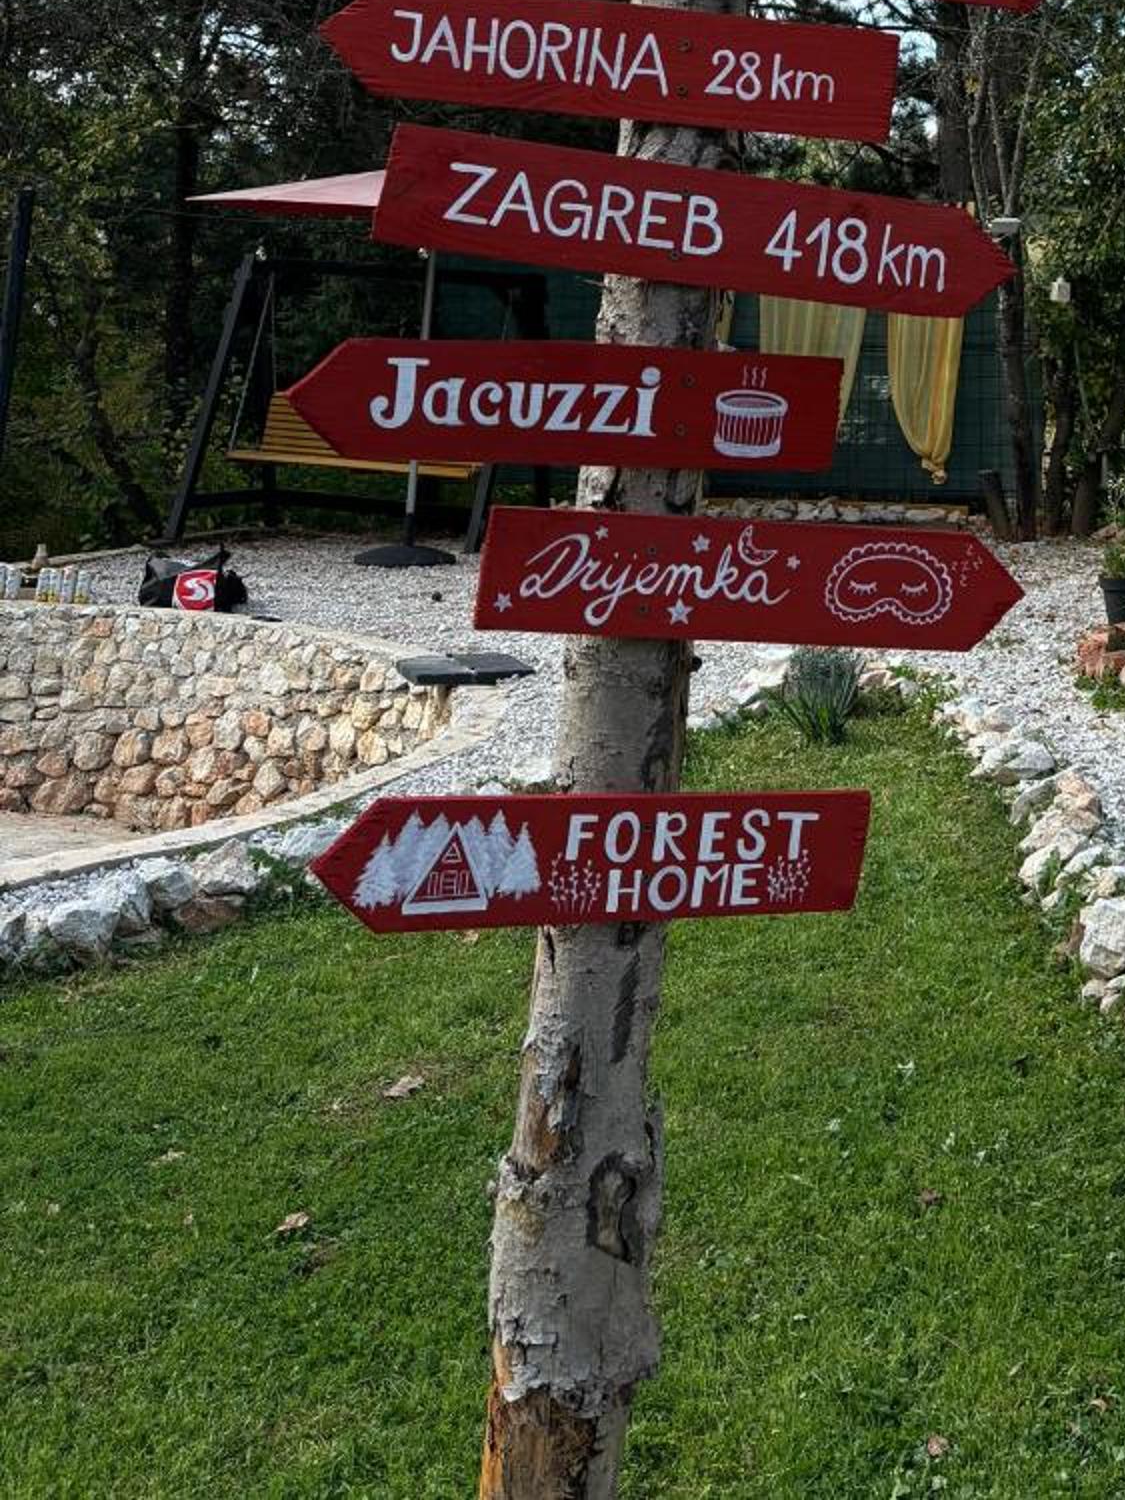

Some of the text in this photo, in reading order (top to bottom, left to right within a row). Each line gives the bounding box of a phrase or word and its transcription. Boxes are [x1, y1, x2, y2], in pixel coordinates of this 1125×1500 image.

[391, 9, 669, 97] JAHORINA
[443, 161, 724, 257] ZAGREB
[370, 357, 660, 438] Jacuzzi
[564, 809, 821, 864] FOREST
[605, 863, 765, 914] HOME
